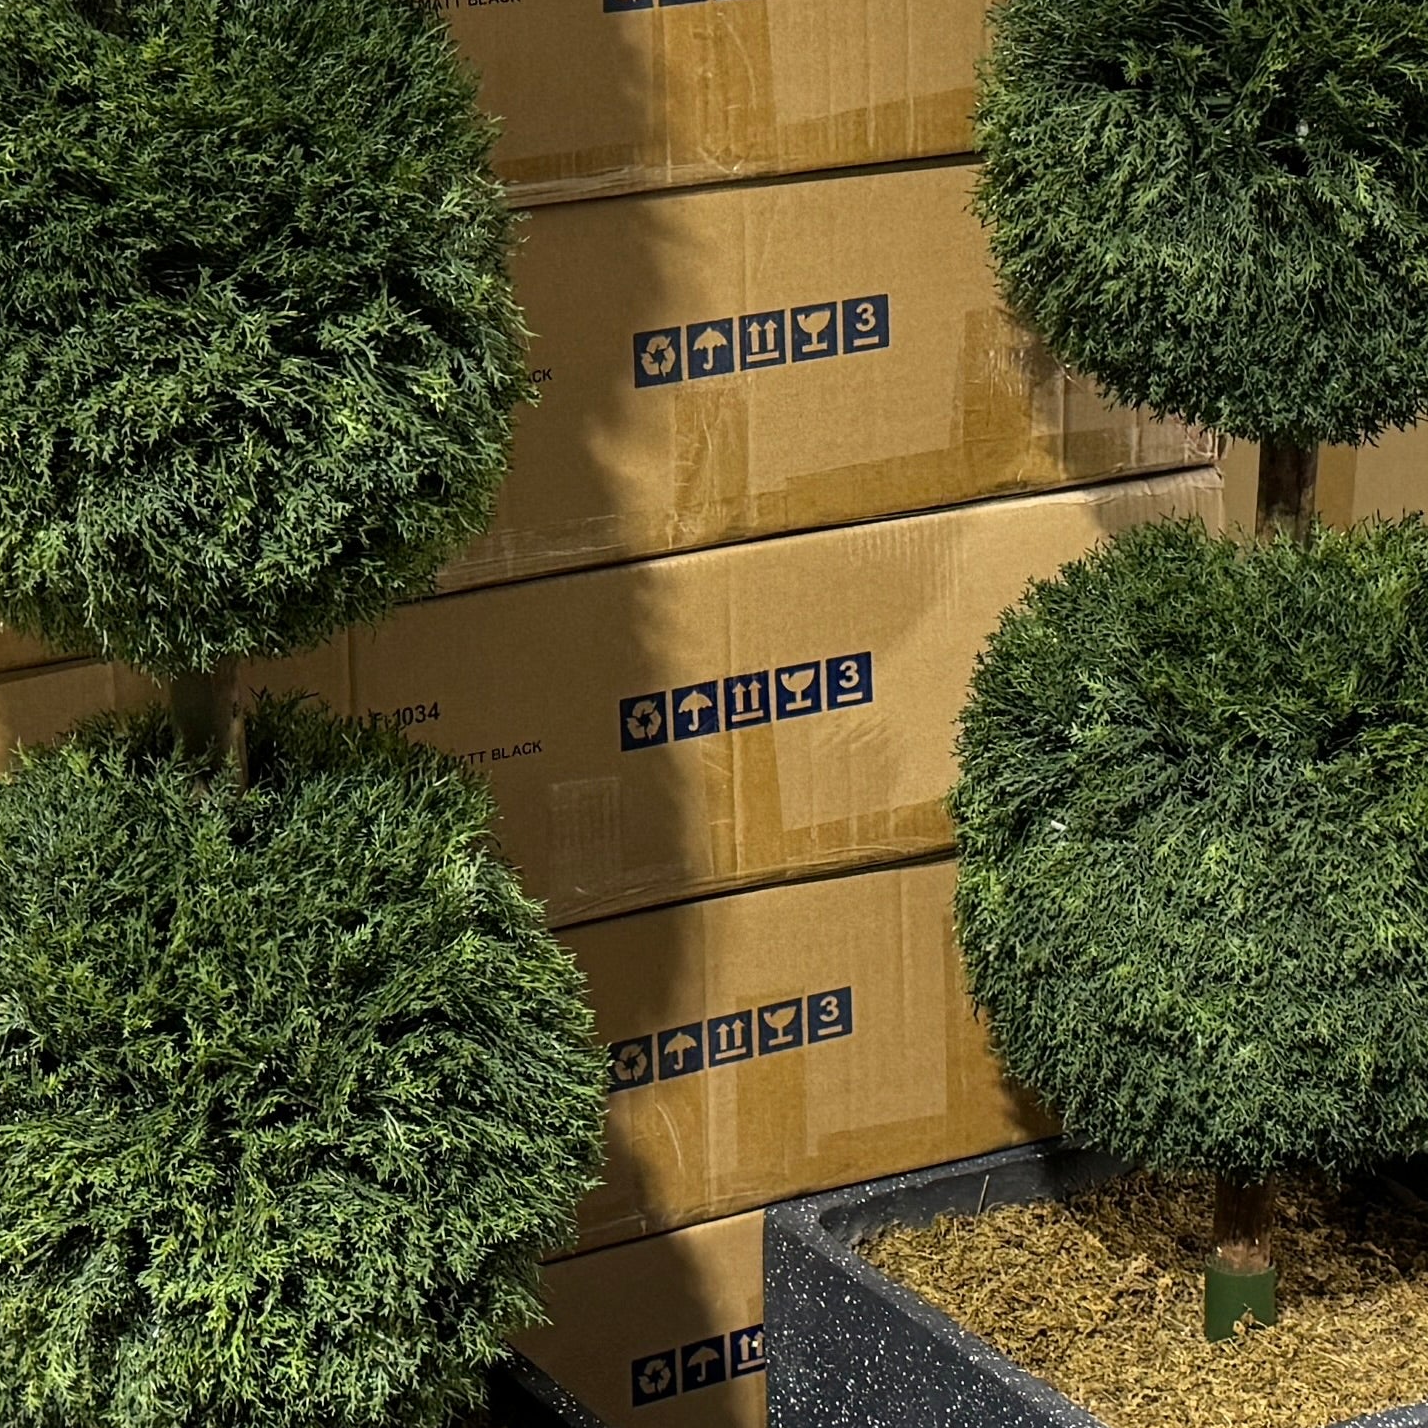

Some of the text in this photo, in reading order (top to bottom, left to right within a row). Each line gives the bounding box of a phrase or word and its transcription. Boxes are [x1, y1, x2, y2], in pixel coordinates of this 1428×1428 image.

[855, 302, 876, 333] 3
[839, 660, 859, 689] 3
[491, 740, 542, 761] BLACK
[819, 995, 840, 1023] 3
